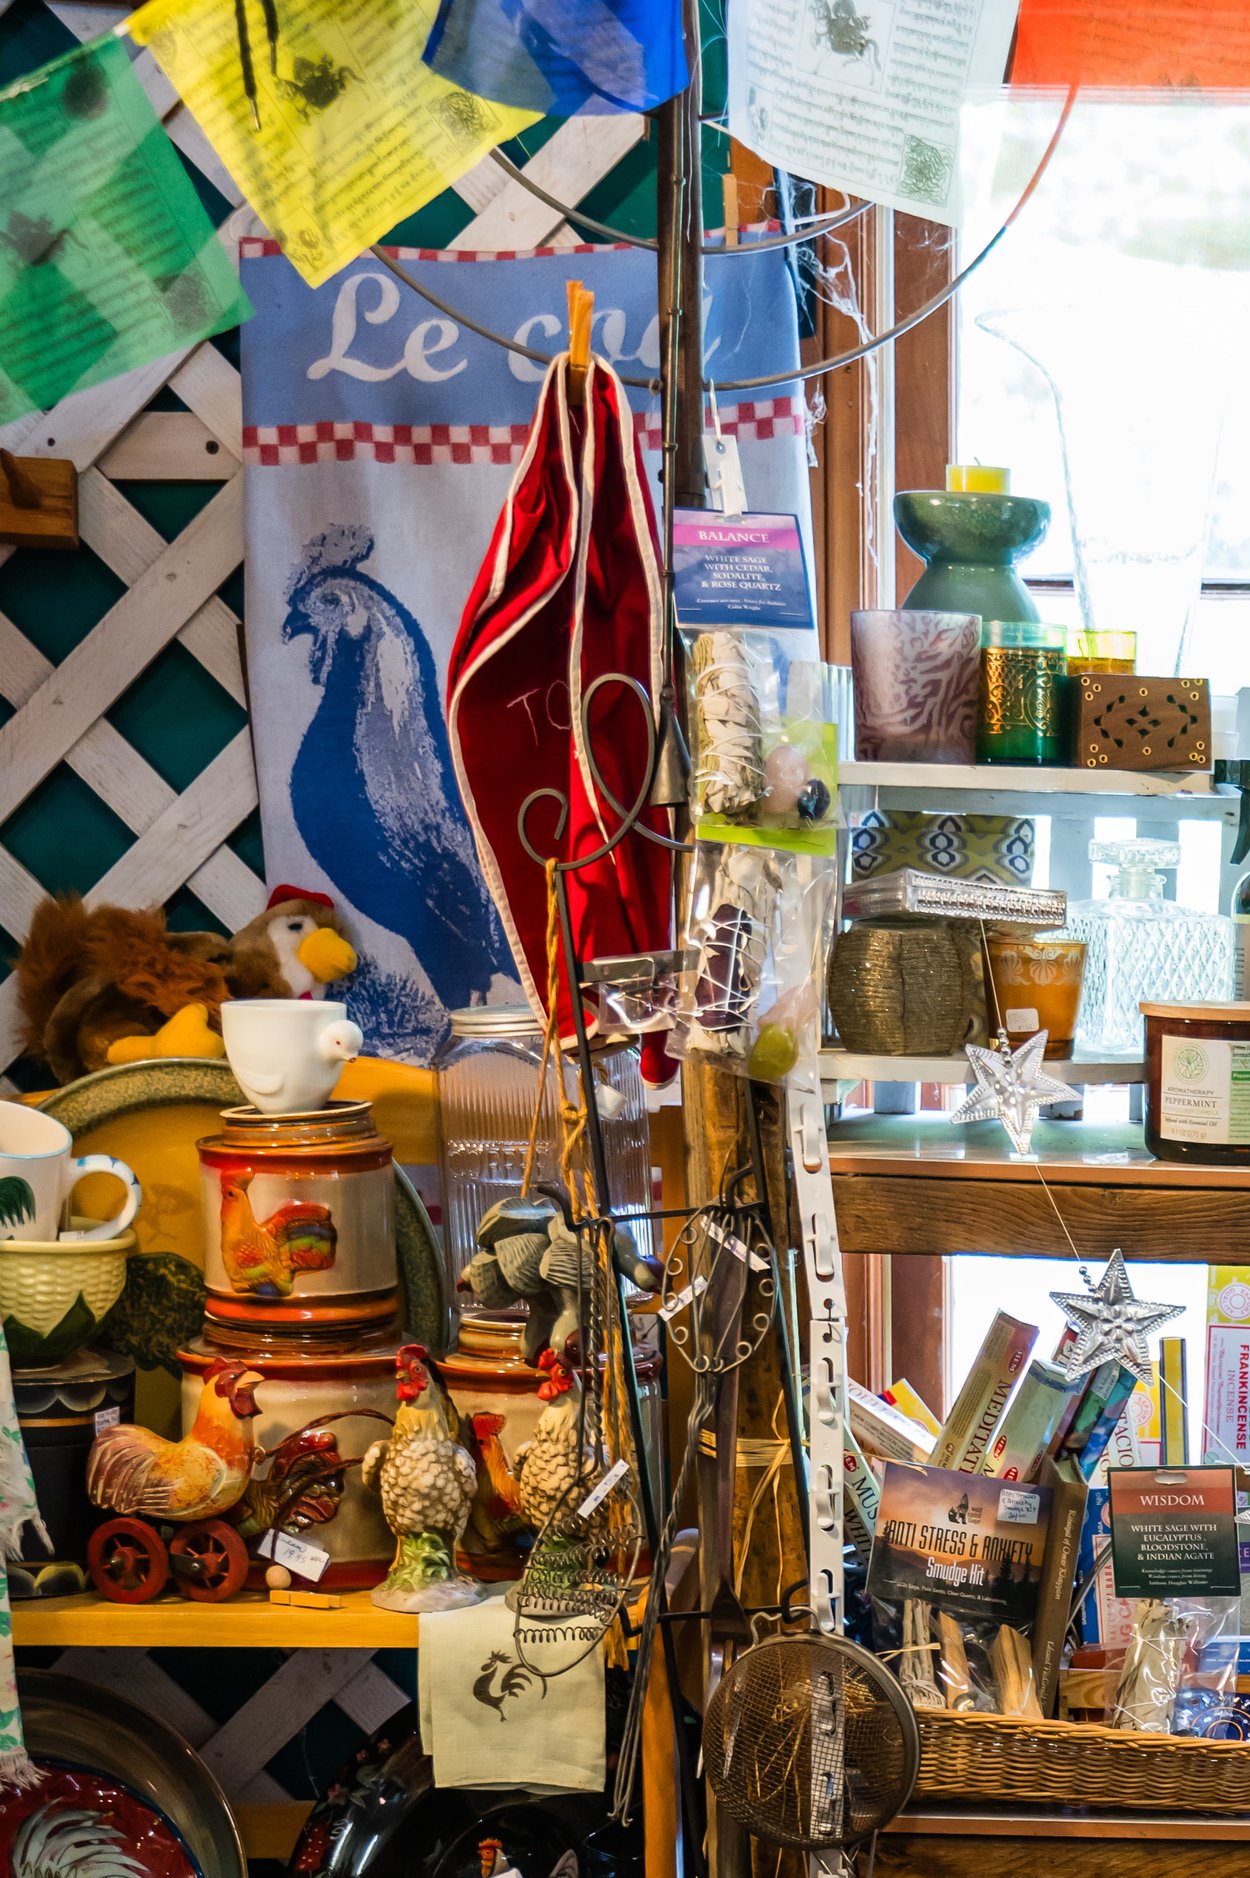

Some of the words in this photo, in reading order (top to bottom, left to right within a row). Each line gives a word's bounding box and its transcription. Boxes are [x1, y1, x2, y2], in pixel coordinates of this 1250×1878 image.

[305, 272, 469, 384] Le
[698, 530, 770, 544] BALANCE
[704, 554, 740, 564] WHITE
[741, 555, 768, 564] SAGE
[704, 563, 734, 571] WITH
[712, 573, 767, 582] SODALITE,
[711, 581, 738, 589] ROSE
[739, 581, 782, 592] QUARTZ
[1168, 1086, 1215, 1096] AROMATHERAPY
[1164, 1096, 1217, 1109] PEPPERMINT
[1225, 1369, 1236, 1423] INCENSE
[1236, 1344, 1250, 1450] FRANKINCENSE
[1139, 1494, 1205, 1506] WISDOM
[1131, 1524, 1163, 1533] WHITE
[1164, 1524, 1189, 1532] SAGE
[1190, 1523, 1217, 1532] WITH
[887, 1519, 918, 1548] ANTI
[919, 1524, 967, 1557] STRESS
[969, 1533, 979, 1558] &
[981, 1535, 1034, 1565] ANXIETY
[1140, 1543, 1209, 1552] BLOODSTONE,
[1146, 1553, 1182, 1561] INDIAN
[1184, 1552, 1215, 1560] AGATE
[926, 1556, 967, 1587] Smudge
[969, 1563, 986, 1587] Kit
